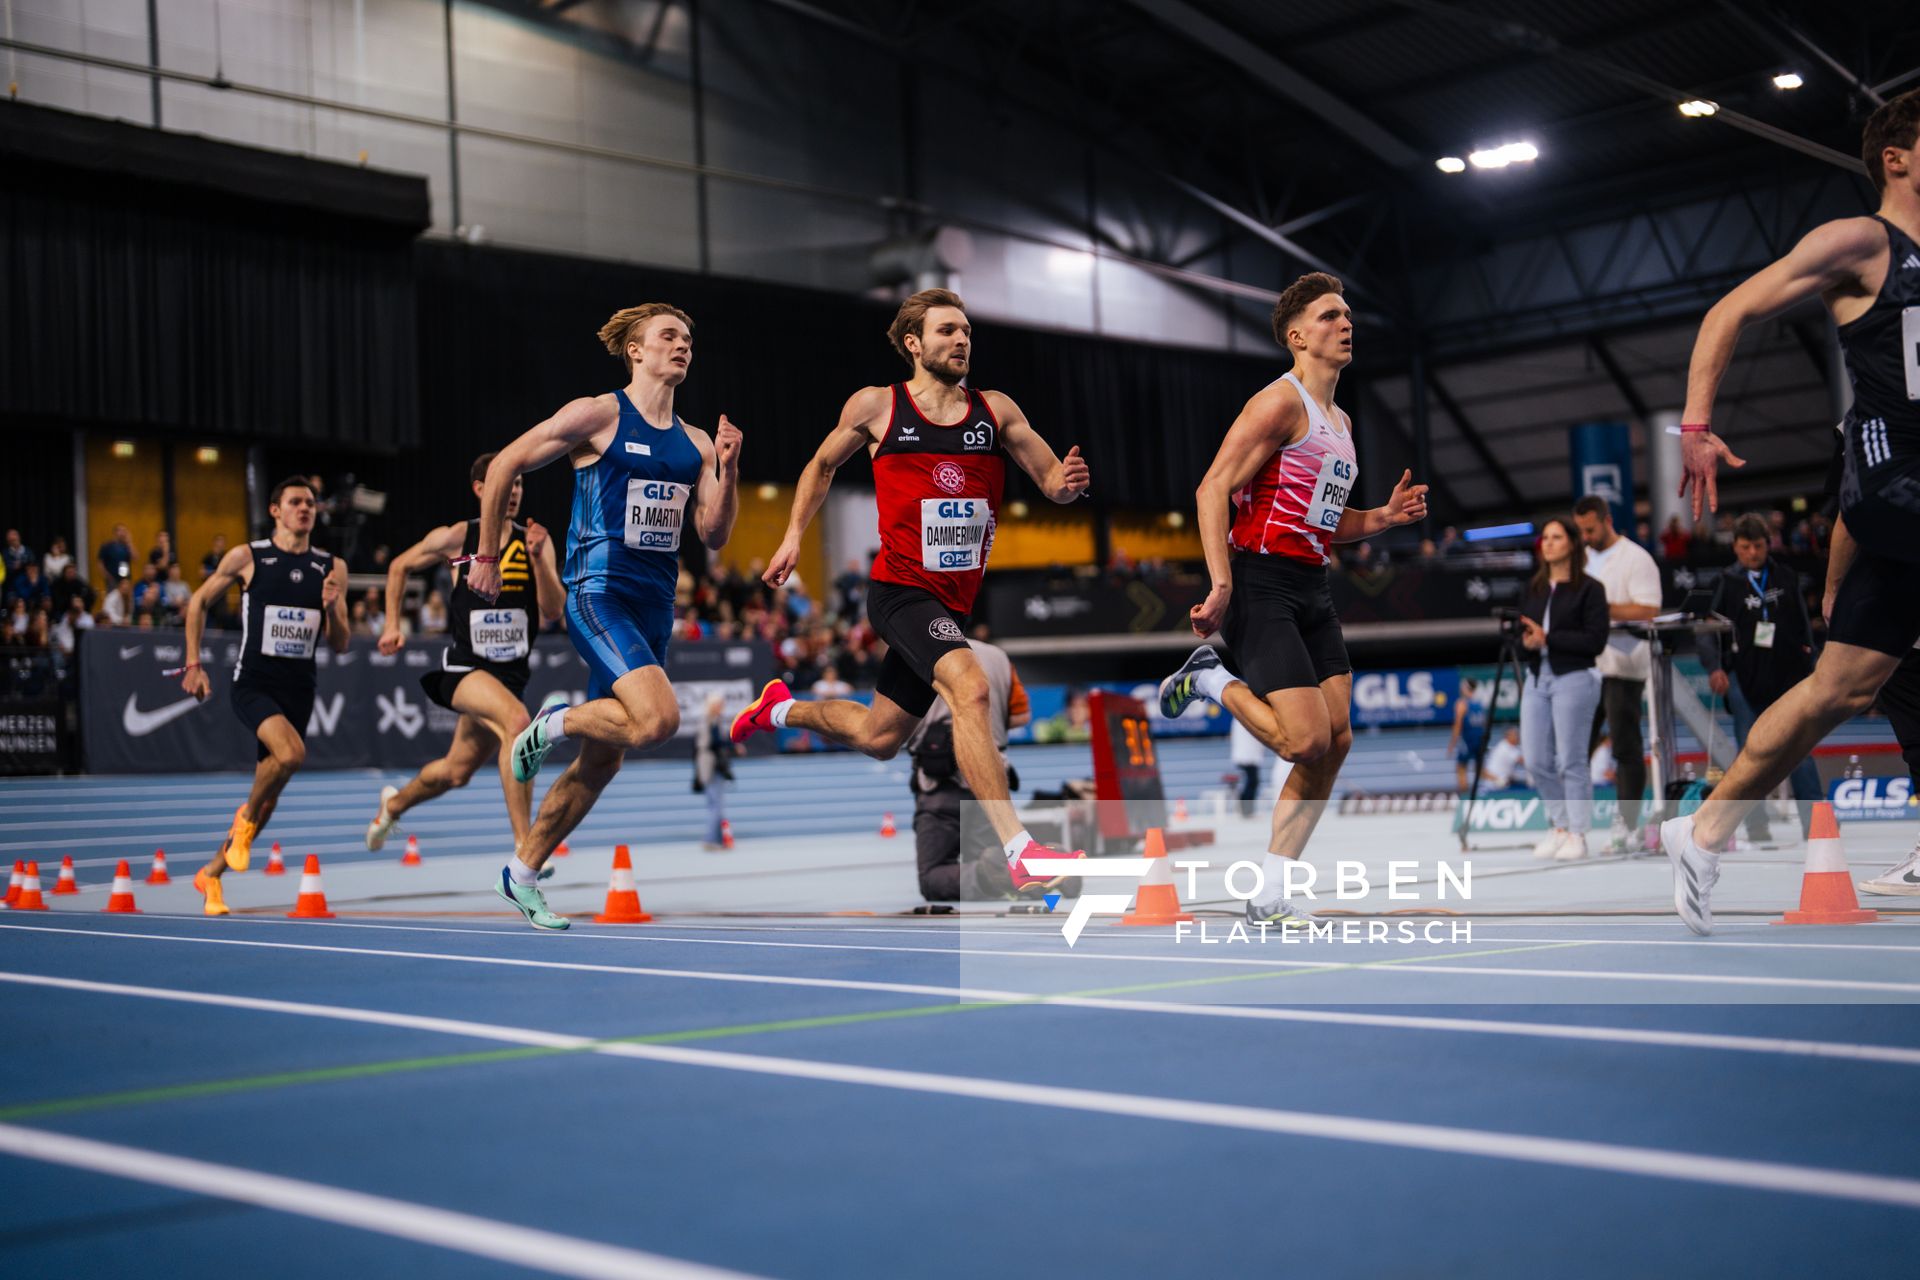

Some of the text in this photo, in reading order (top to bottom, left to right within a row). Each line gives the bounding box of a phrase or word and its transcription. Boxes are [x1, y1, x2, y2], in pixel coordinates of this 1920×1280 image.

[963, 430, 986, 445] OS
[1334, 460, 1351, 481] GLS
[632, 505, 681, 528] R.MARTIN
[278, 609, 305, 621] GLS
[484, 612, 513, 624] GLS
[271, 623, 312, 641] BUSAM
[474, 628, 525, 644] LEPPELSACK
